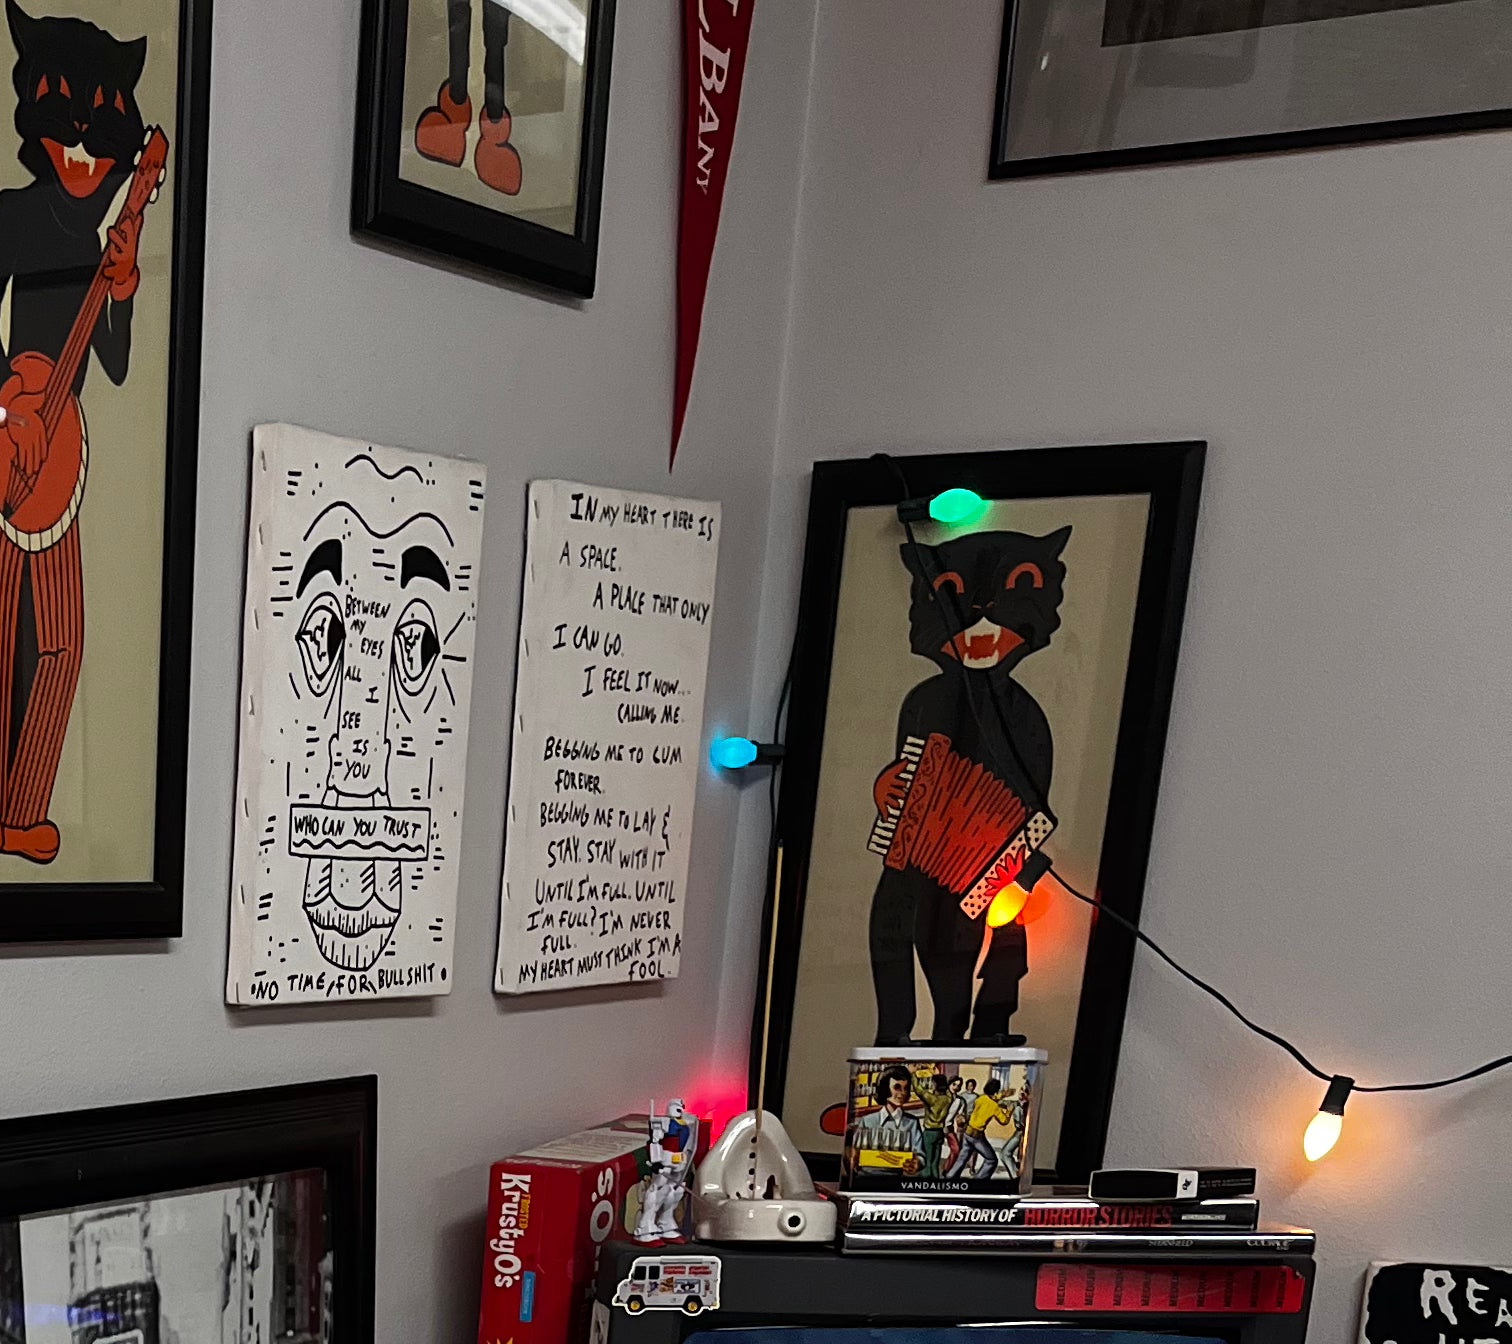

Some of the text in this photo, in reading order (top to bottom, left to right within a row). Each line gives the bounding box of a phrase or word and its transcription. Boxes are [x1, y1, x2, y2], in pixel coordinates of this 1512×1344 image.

[570, 493, 714, 541] IN MY HEART THERE IS
[559, 541, 621, 571] A SPACE.
[345, 594, 390, 618] BETWEEN
[593, 582, 603, 609] A
[652, 594, 679, 615] THAT
[681, 599, 710, 625] ONLY
[351, 620, 366, 635] MY
[553, 624, 567, 649] I
[573, 625, 599, 650] CAN
[361, 637, 384, 659] EYES
[345, 665, 361, 682] ALL
[582, 665, 596, 697] I
[603, 668, 630, 692] FEEL
[635, 671, 651, 692] IT
[365, 687, 379, 703] I
[342, 711, 360, 729] SEE
[617, 703, 656, 723] CALLING
[353, 740, 369, 756] IS
[544, 736, 600, 761] BEGGING
[605, 745, 622, 762] ME
[629, 746, 643, 763] TO
[344, 759, 370, 780] YOU
[294, 815, 421, 838] WHO CAN YOU TRUST
[540, 801, 589, 827] BEGGING
[594, 808, 613, 827] ME
[619, 811, 629, 830] TO
[634, 808, 656, 835] LAY
[588, 839, 616, 864] STAY
[620, 847, 647, 870] WITH
[653, 851, 665, 871] IT
[535, 874, 675, 905] UNTIL I'M FULL. UNTIL
[527, 906, 670, 937] I'M FULL? I'M NEVER
[519, 961, 538, 983] MY
[541, 958, 573, 981] HEART
[577, 950, 604, 976] MUST
[605, 938, 641, 968] THINK
[647, 936, 670, 958] I'M
[288, 972, 325, 992] TIME
[378, 963, 435, 988] BULLSHIT
[901, 1182, 969, 1191] VANDALISMO
[861, 1208, 872, 1222] A
[873, 1208, 940, 1222] PICTORIAL
[941, 1208, 998, 1222] HISTORY
[998, 1208, 1018, 1222] OF
[1025, 1206, 1098, 1227] HORROR
[1099, 1206, 1172, 1227] STORIES
